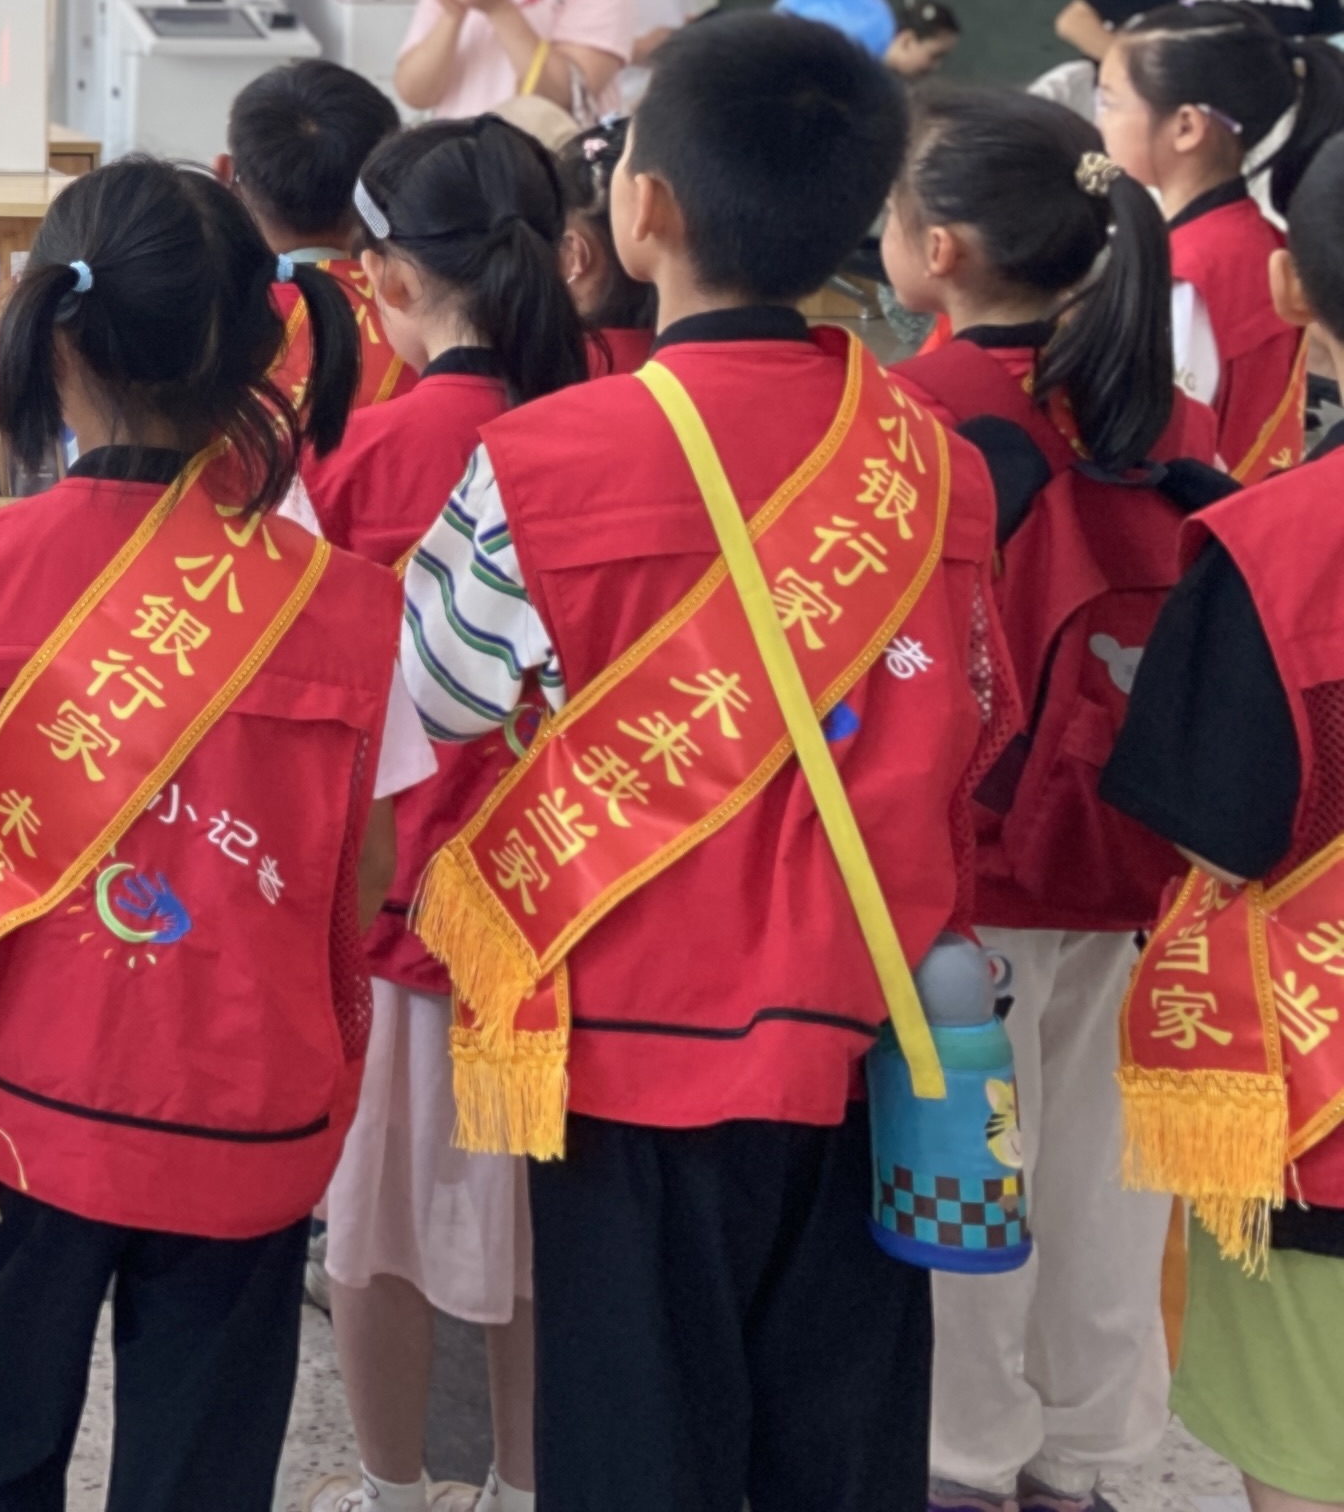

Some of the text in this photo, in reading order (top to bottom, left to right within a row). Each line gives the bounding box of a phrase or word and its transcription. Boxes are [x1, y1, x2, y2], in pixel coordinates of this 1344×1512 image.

[36, 503, 283, 783] 小小银行家
[489, 668, 753, 916] 未来我当家
